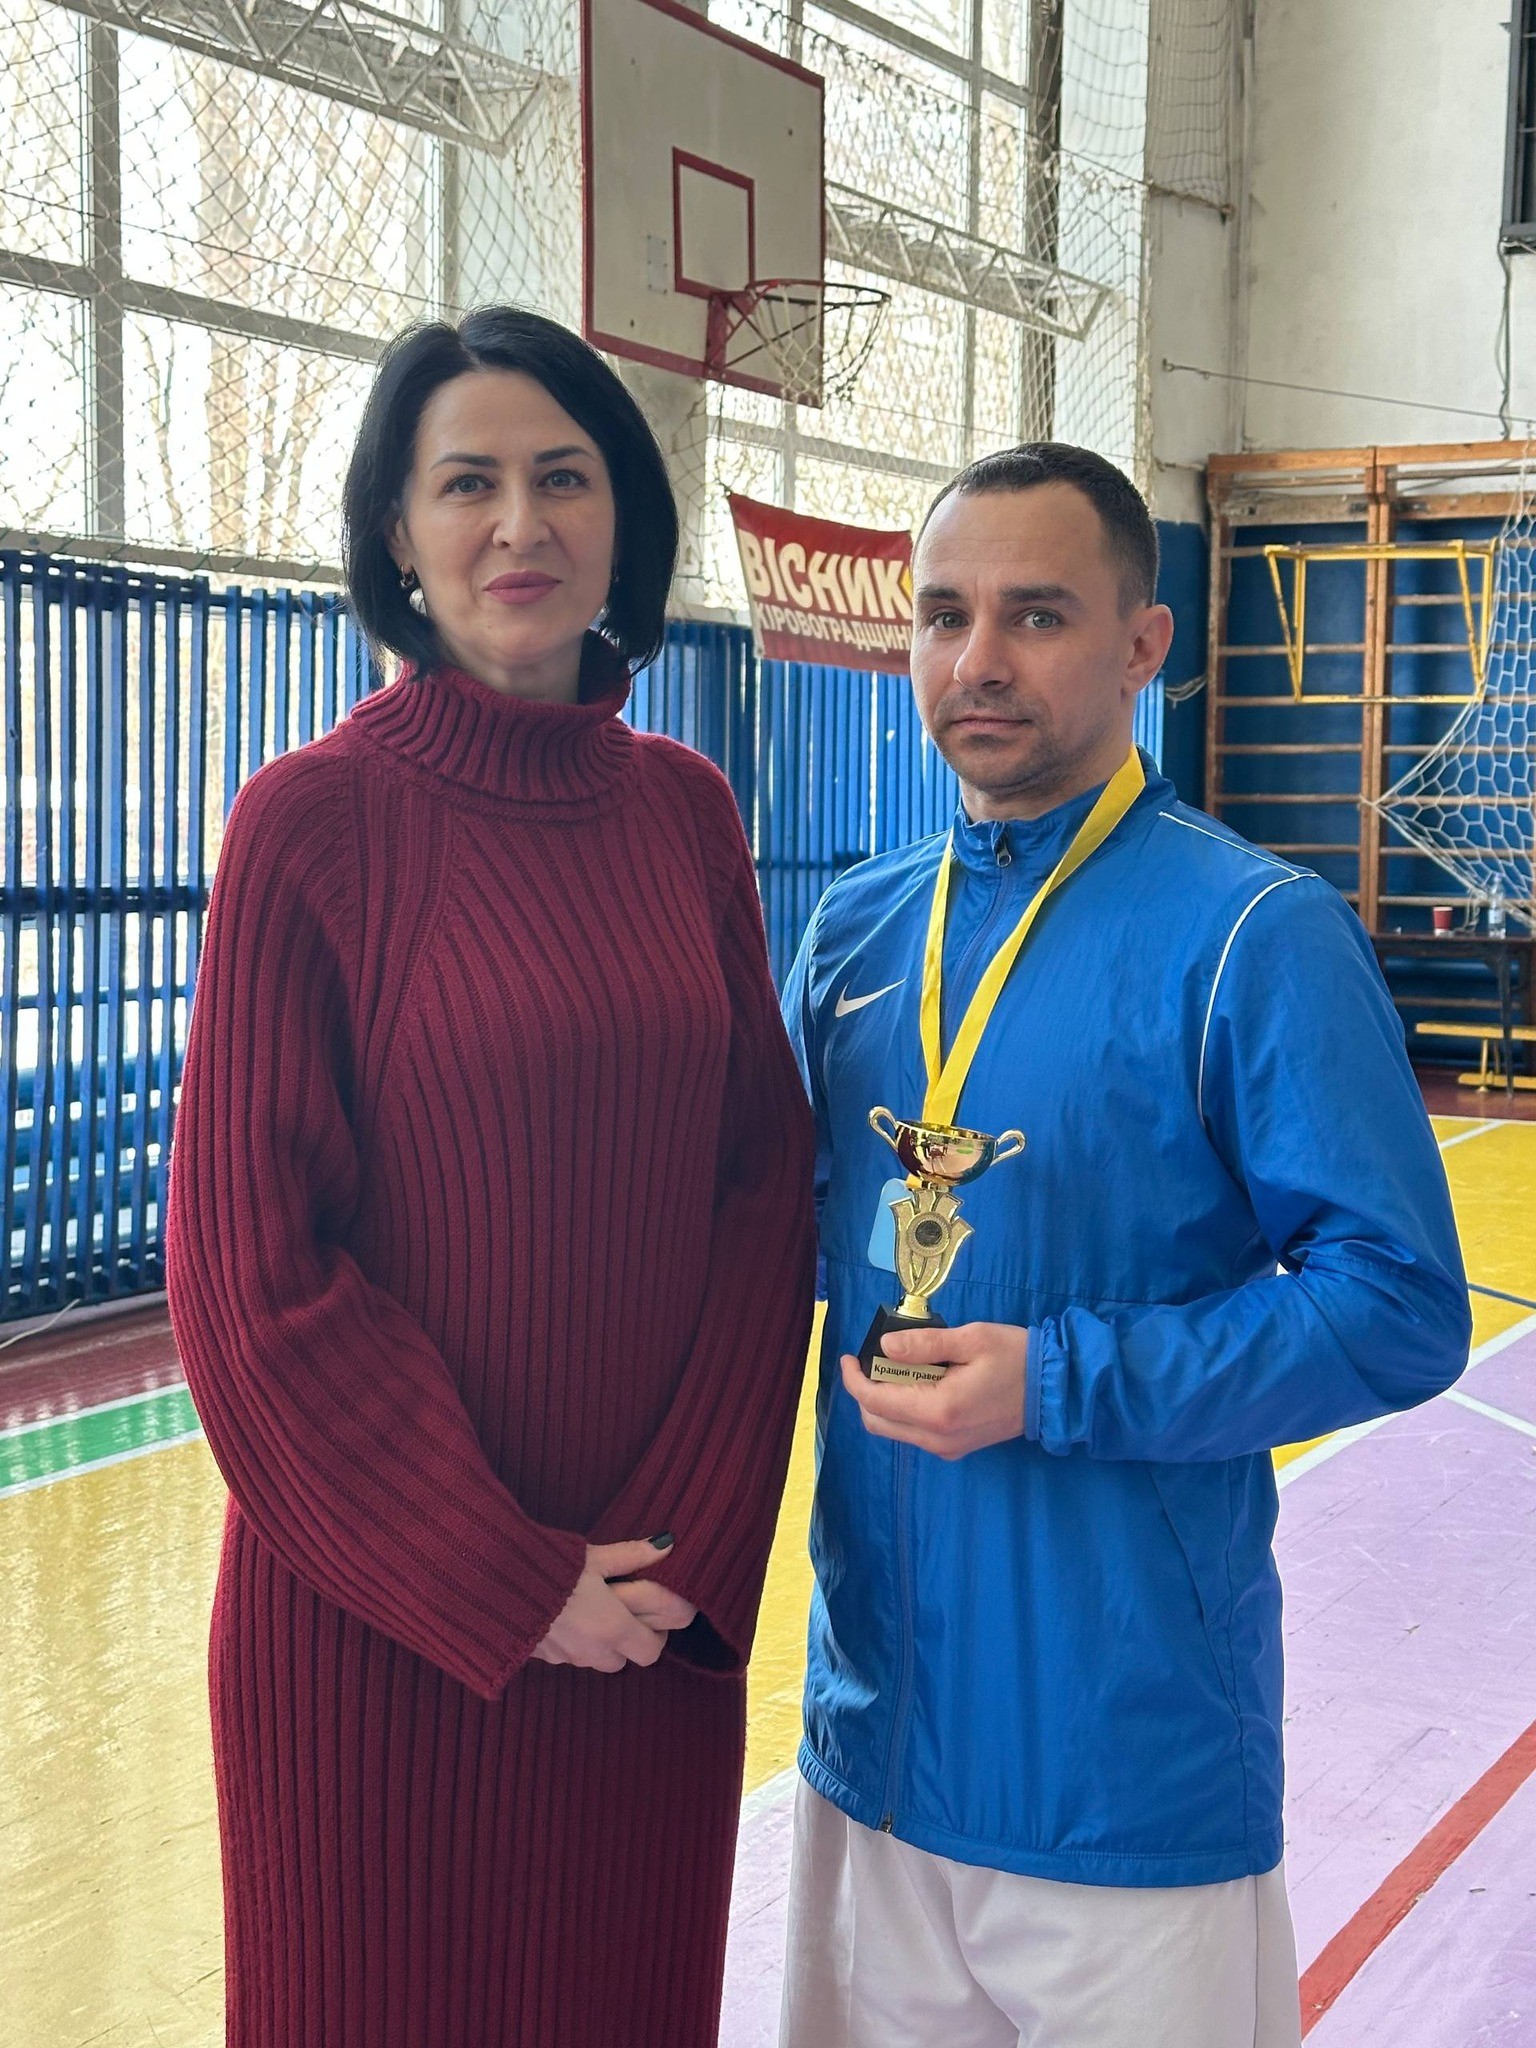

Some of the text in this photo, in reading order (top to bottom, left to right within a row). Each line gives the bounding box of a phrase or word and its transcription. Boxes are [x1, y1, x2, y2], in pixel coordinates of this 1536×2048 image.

[738, 528, 913, 620] ВІСНИК
[753, 601, 912, 654] КІРОВОГРАДЩИН
[874, 1363, 910, 1377] Кращий
